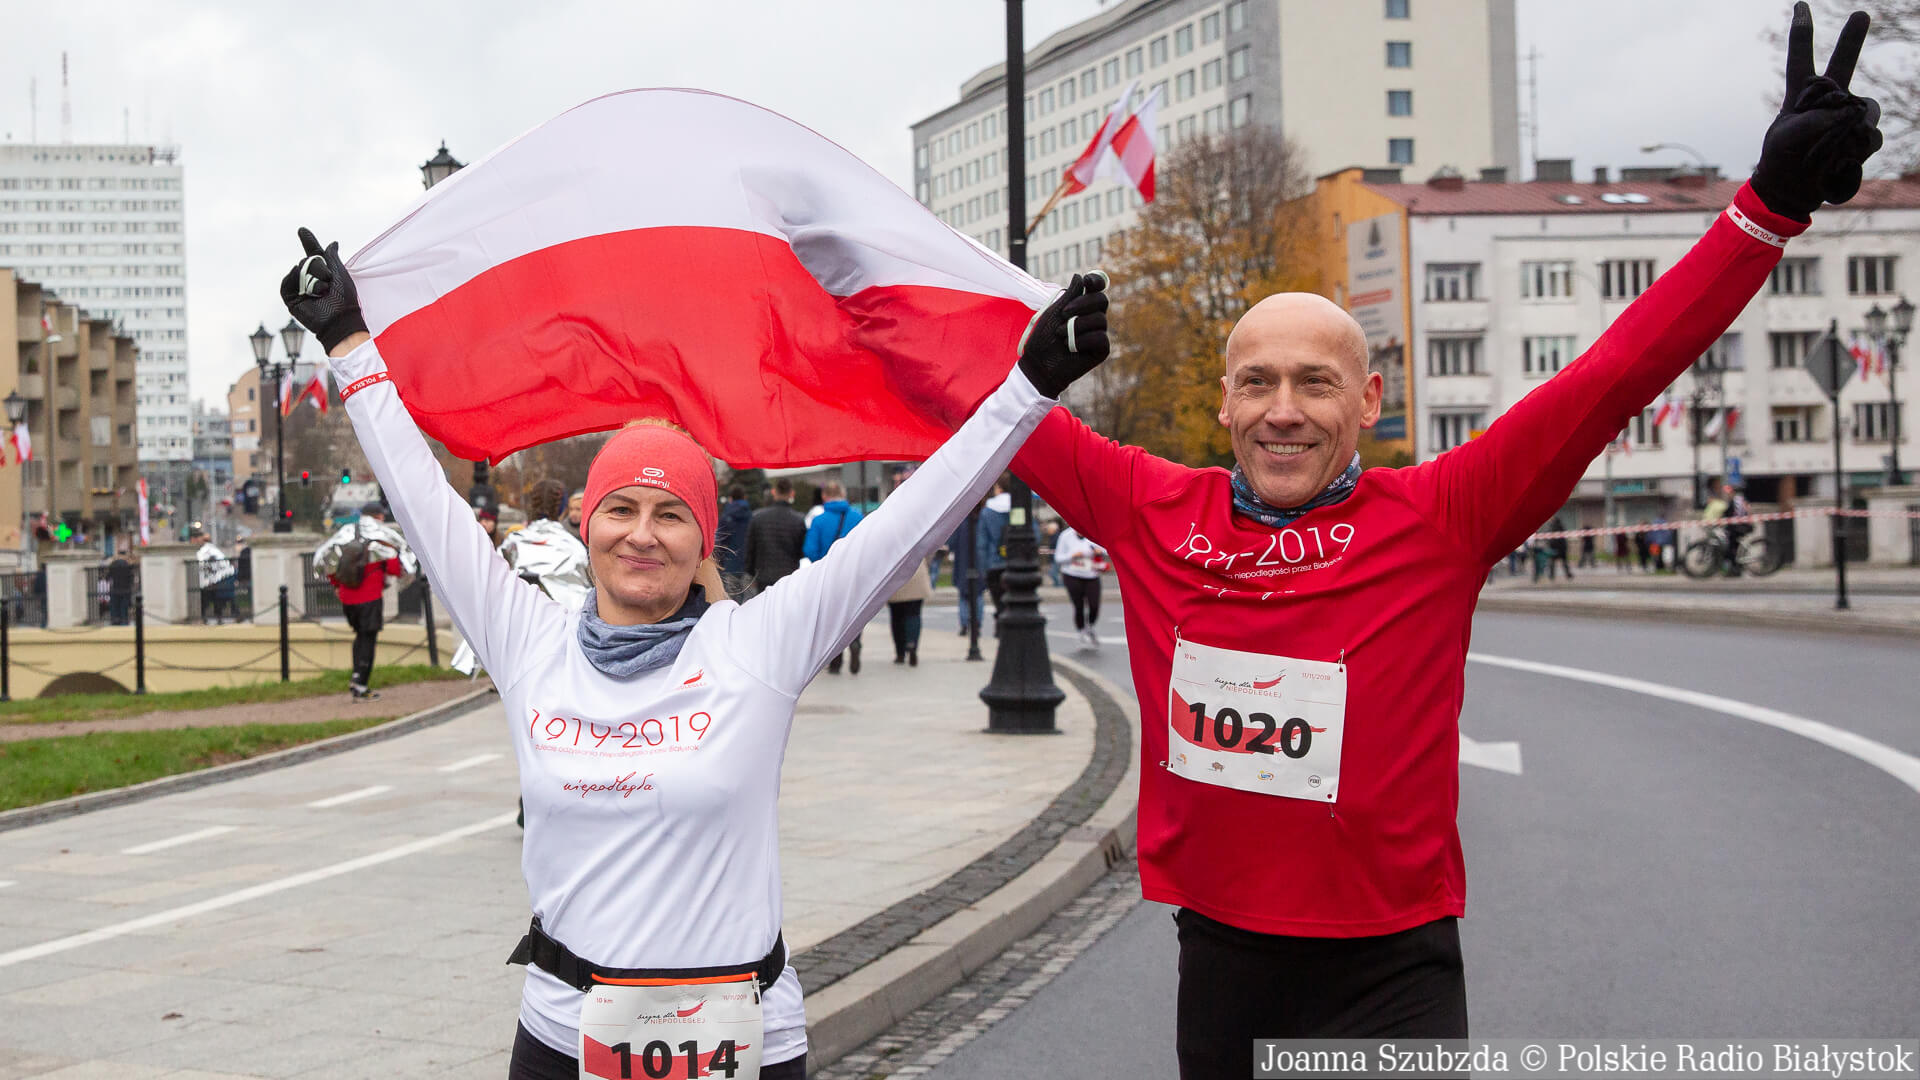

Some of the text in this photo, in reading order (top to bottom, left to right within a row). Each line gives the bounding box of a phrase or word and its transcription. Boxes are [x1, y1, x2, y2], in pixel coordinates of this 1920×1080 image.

[1744, 222, 1773, 242] POLSKA
[352, 376, 377, 390] POLSKA
[634, 476, 670, 488] Kalenji
[1291, 564, 1312, 575] przez
[1226, 685, 1283, 699] NIEPODLEGŁEJ
[530, 708, 712, 748] 1919-2019
[1189, 702, 1312, 759] 1020
[650, 1017, 706, 1025] NIEPODLEGŁEJ
[611, 1039, 739, 1079] 1014
